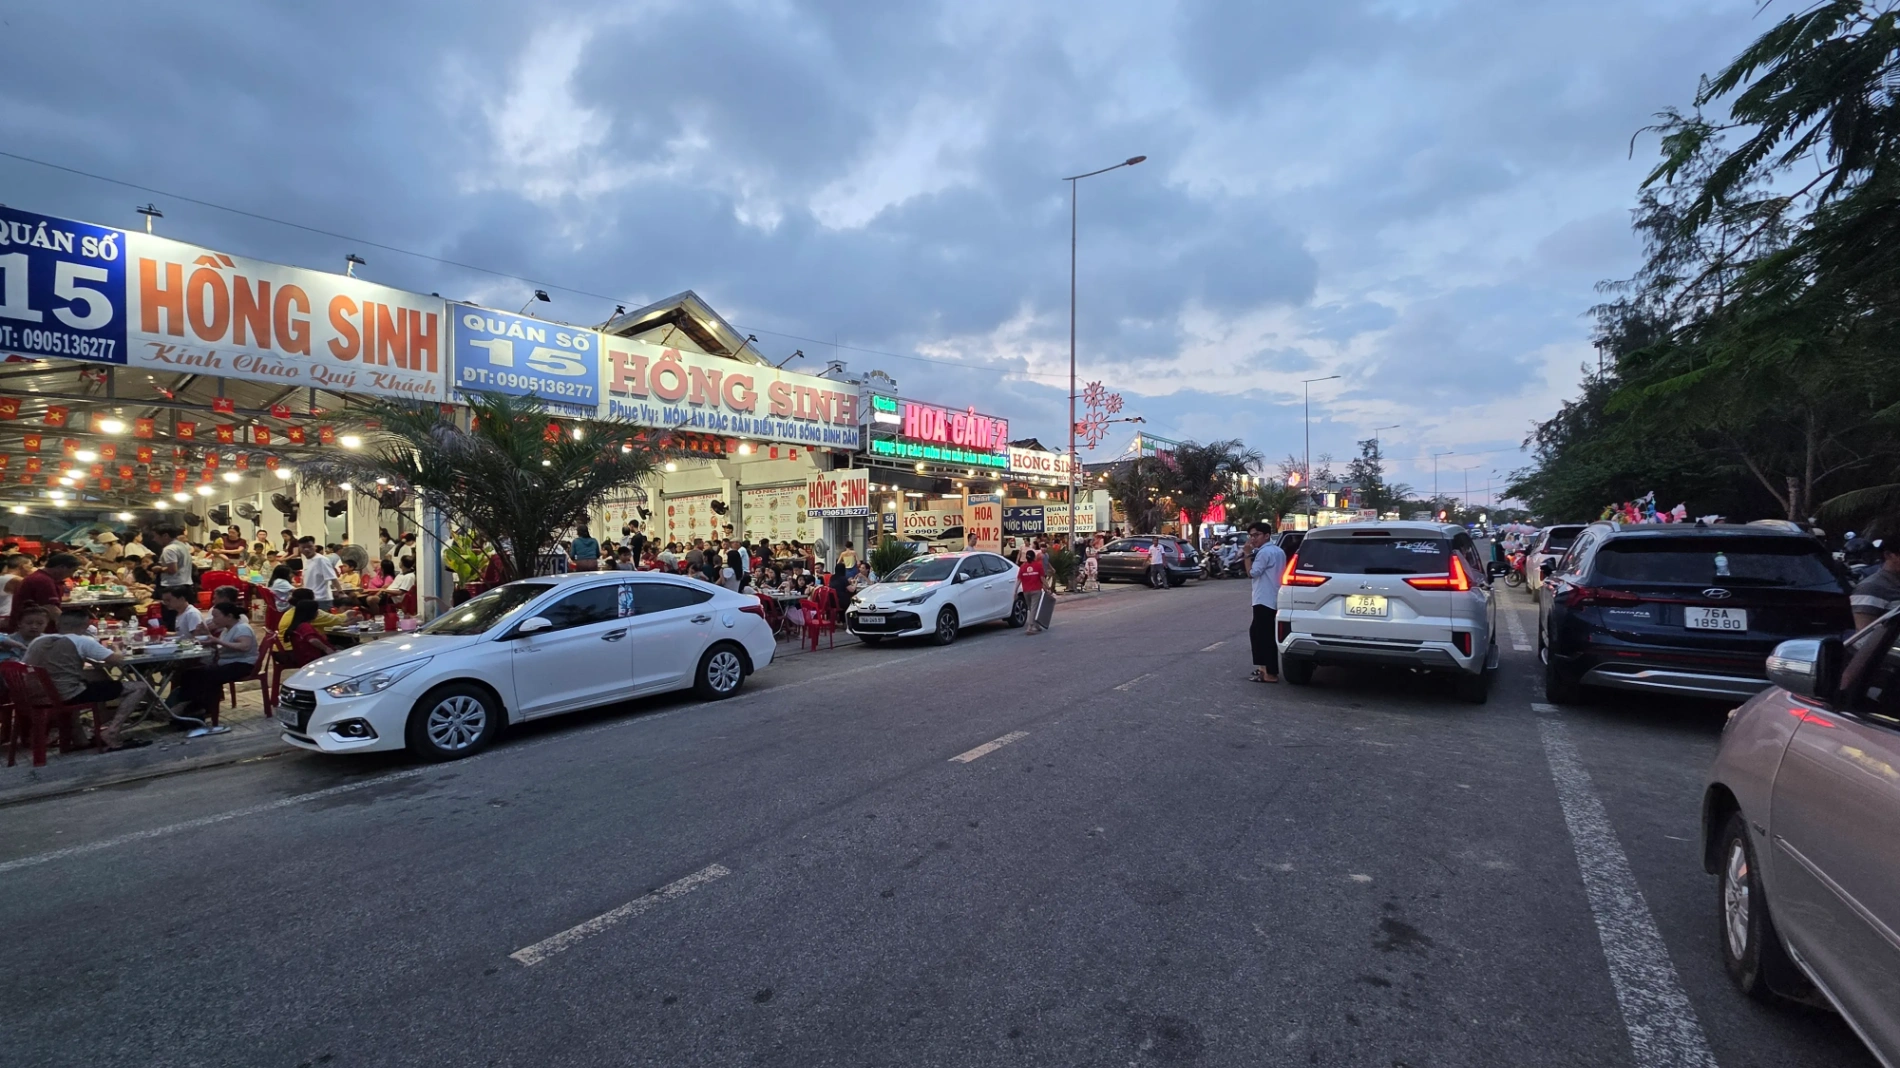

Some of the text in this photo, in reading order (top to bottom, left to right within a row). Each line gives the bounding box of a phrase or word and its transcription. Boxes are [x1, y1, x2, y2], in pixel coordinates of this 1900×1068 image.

[81, 232, 119, 261] SỐ
[0, 252, 114, 330] 15
[138, 253, 439, 373] HỒNG SINH
[23, 328, 116, 359] 0905136277
[463, 314, 592, 351] QUÁN SỐ
[140, 342, 437, 395] Kính Chào Quý Khách
[469, 338, 587, 377] 15
[463, 366, 593, 398] ĐT: 0905136277
[608, 348, 860, 428] HỒNG SINH
[609, 399, 639, 421] Phục
[663, 404, 688, 425] MÓN
[731, 413, 751, 434] SẢN
[776, 420, 797, 440] TƯƠI
[799, 422, 821, 443] SỐNG
[823, 424, 841, 445] BÌNH
[842, 429, 858, 447] DÂN
[904, 404, 1008, 451] HOA CẢM 2
[1012, 451, 1081, 475] HỒNG SINH
[808, 474, 867, 509] HỒNG SINH
[943, 515, 964, 527] SIN
[974, 506, 993, 520] HOA
[1019, 508, 1042, 517] XE
[1022, 520, 1043, 533] NGỌT
[993, 527, 999, 541] 2
[1349, 606, 1383, 616] 482.91
[1357, 597, 1375, 607] 76A
[1702, 608, 1729, 619] 76A
[1694, 618, 1741, 630] 189.80
